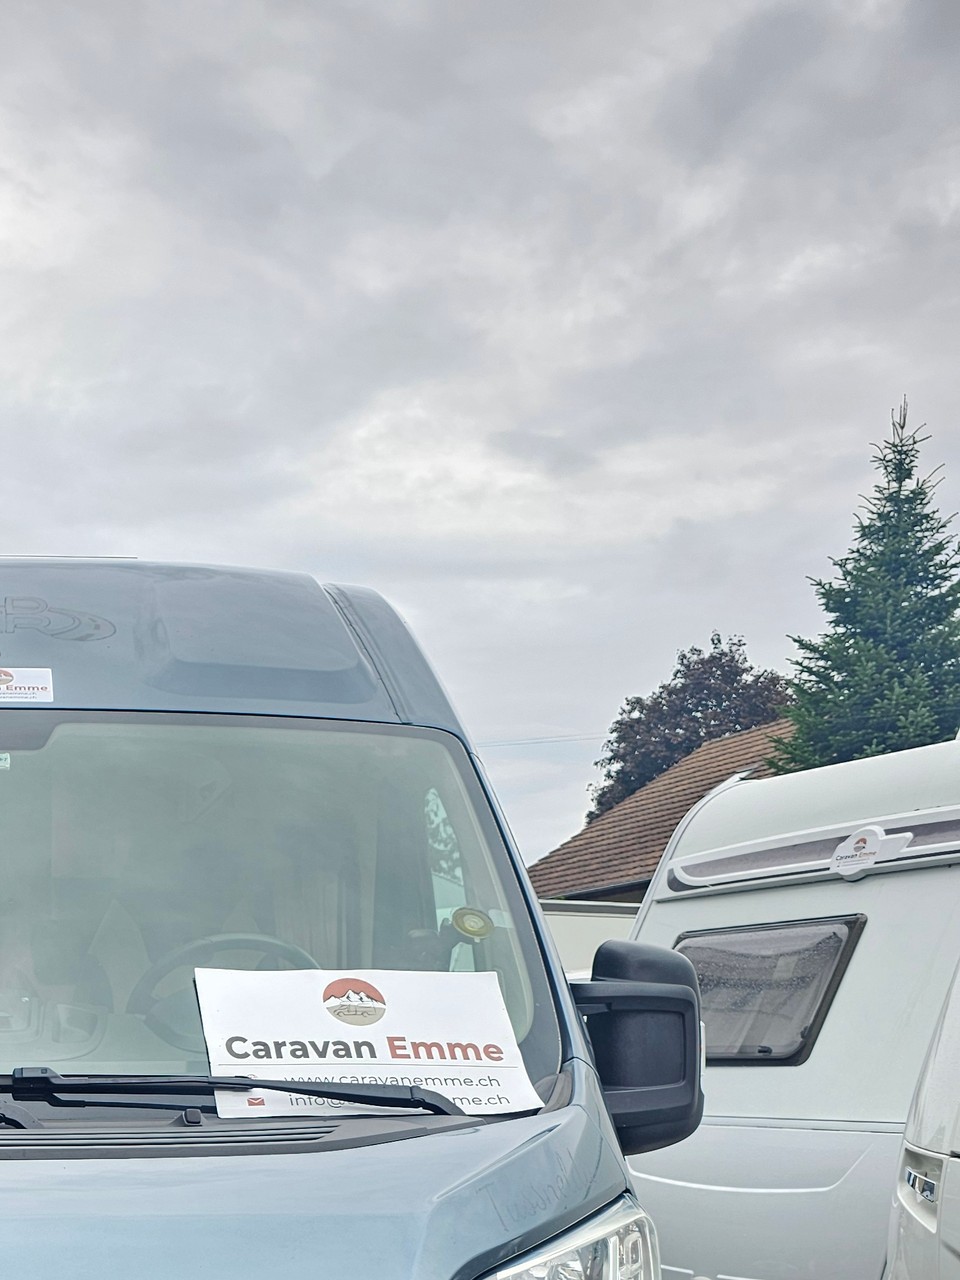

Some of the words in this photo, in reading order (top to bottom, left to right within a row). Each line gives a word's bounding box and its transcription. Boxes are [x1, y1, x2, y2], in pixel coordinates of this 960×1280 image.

[5, 684, 49, 692] Emme
[225, 1036, 377, 1060] Caravan
[386, 1036, 504, 1062] Emme
